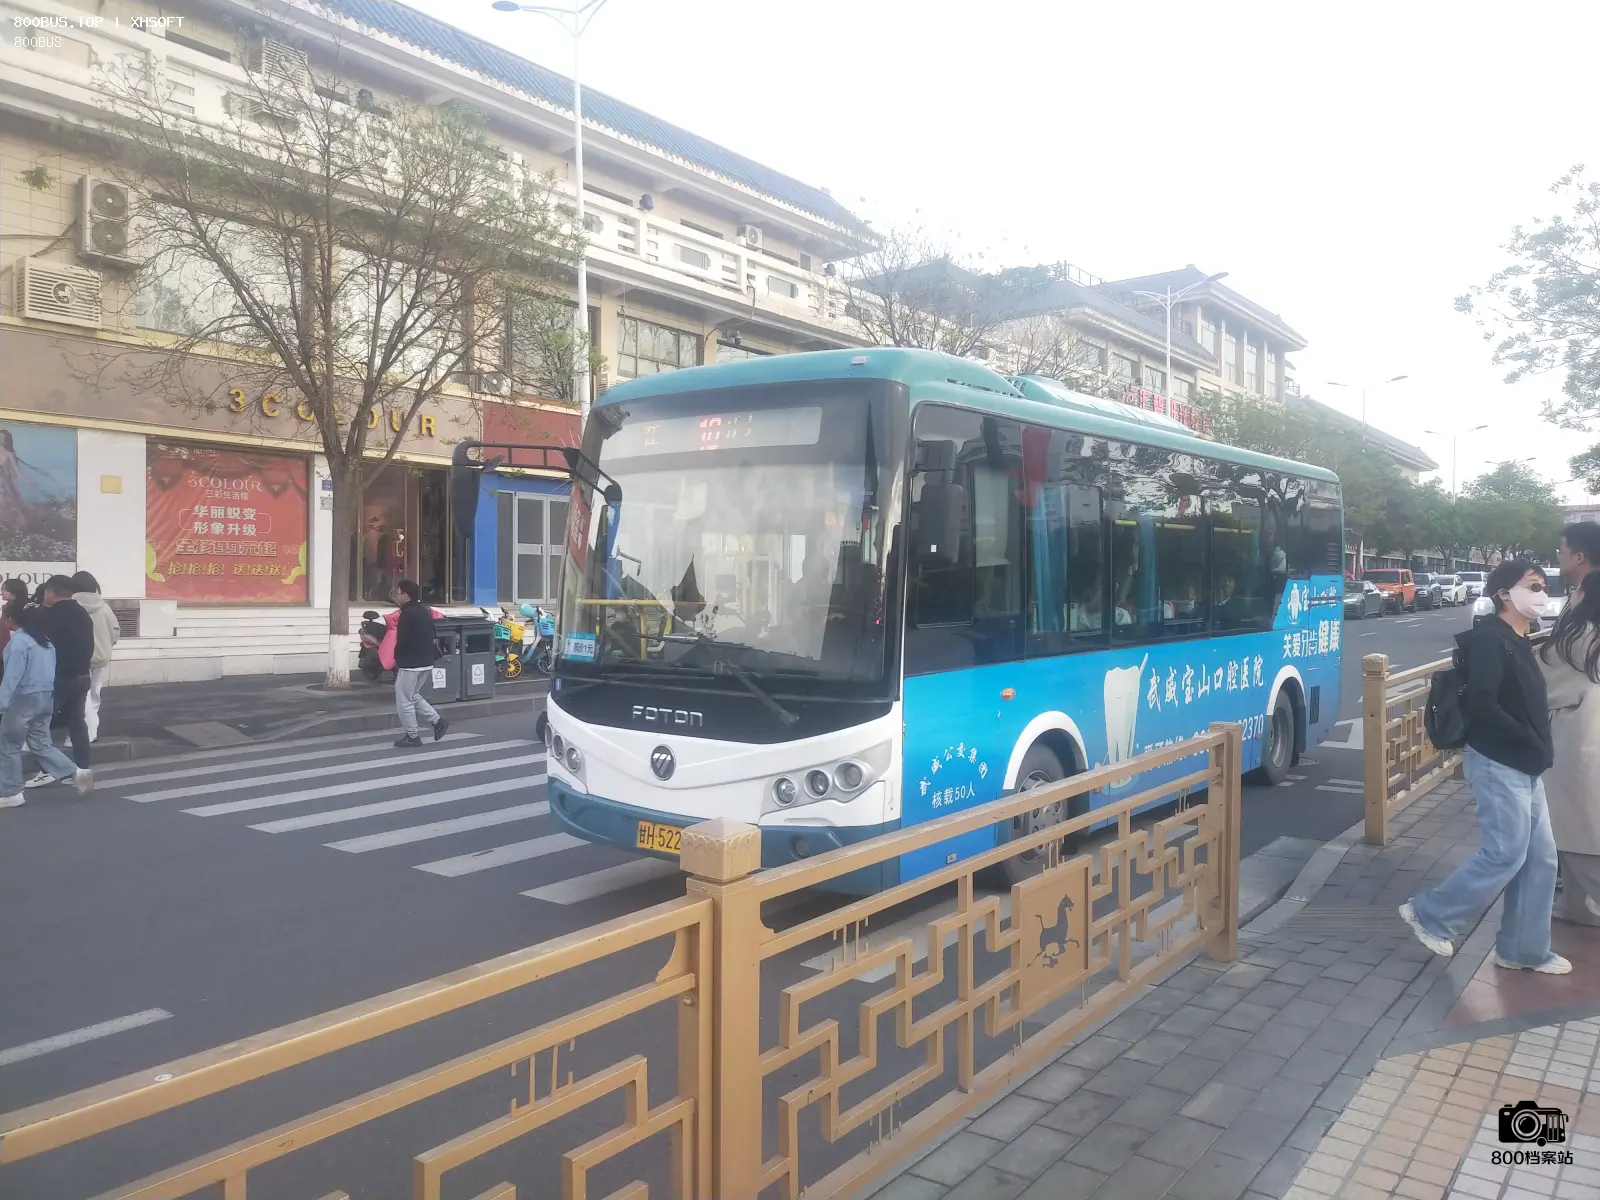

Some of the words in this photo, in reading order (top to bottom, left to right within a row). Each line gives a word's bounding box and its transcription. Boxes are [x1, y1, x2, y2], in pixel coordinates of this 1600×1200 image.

[188, 475, 263, 492] 3COLOUR
[206, 489, 249, 501] 三彩生活馆
[193, 504, 257, 521] 华丽蜕变
[193, 521, 257, 537] 形象升级
[175, 538, 277, 557] 全场99元起
[1282, 618, 1341, 660] 关爱牙齿健康
[1146, 653, 1265, 713] 武威宝山口腔医院
[632, 704, 703, 728] FOTON
[931, 780, 976, 809] 核载50人
